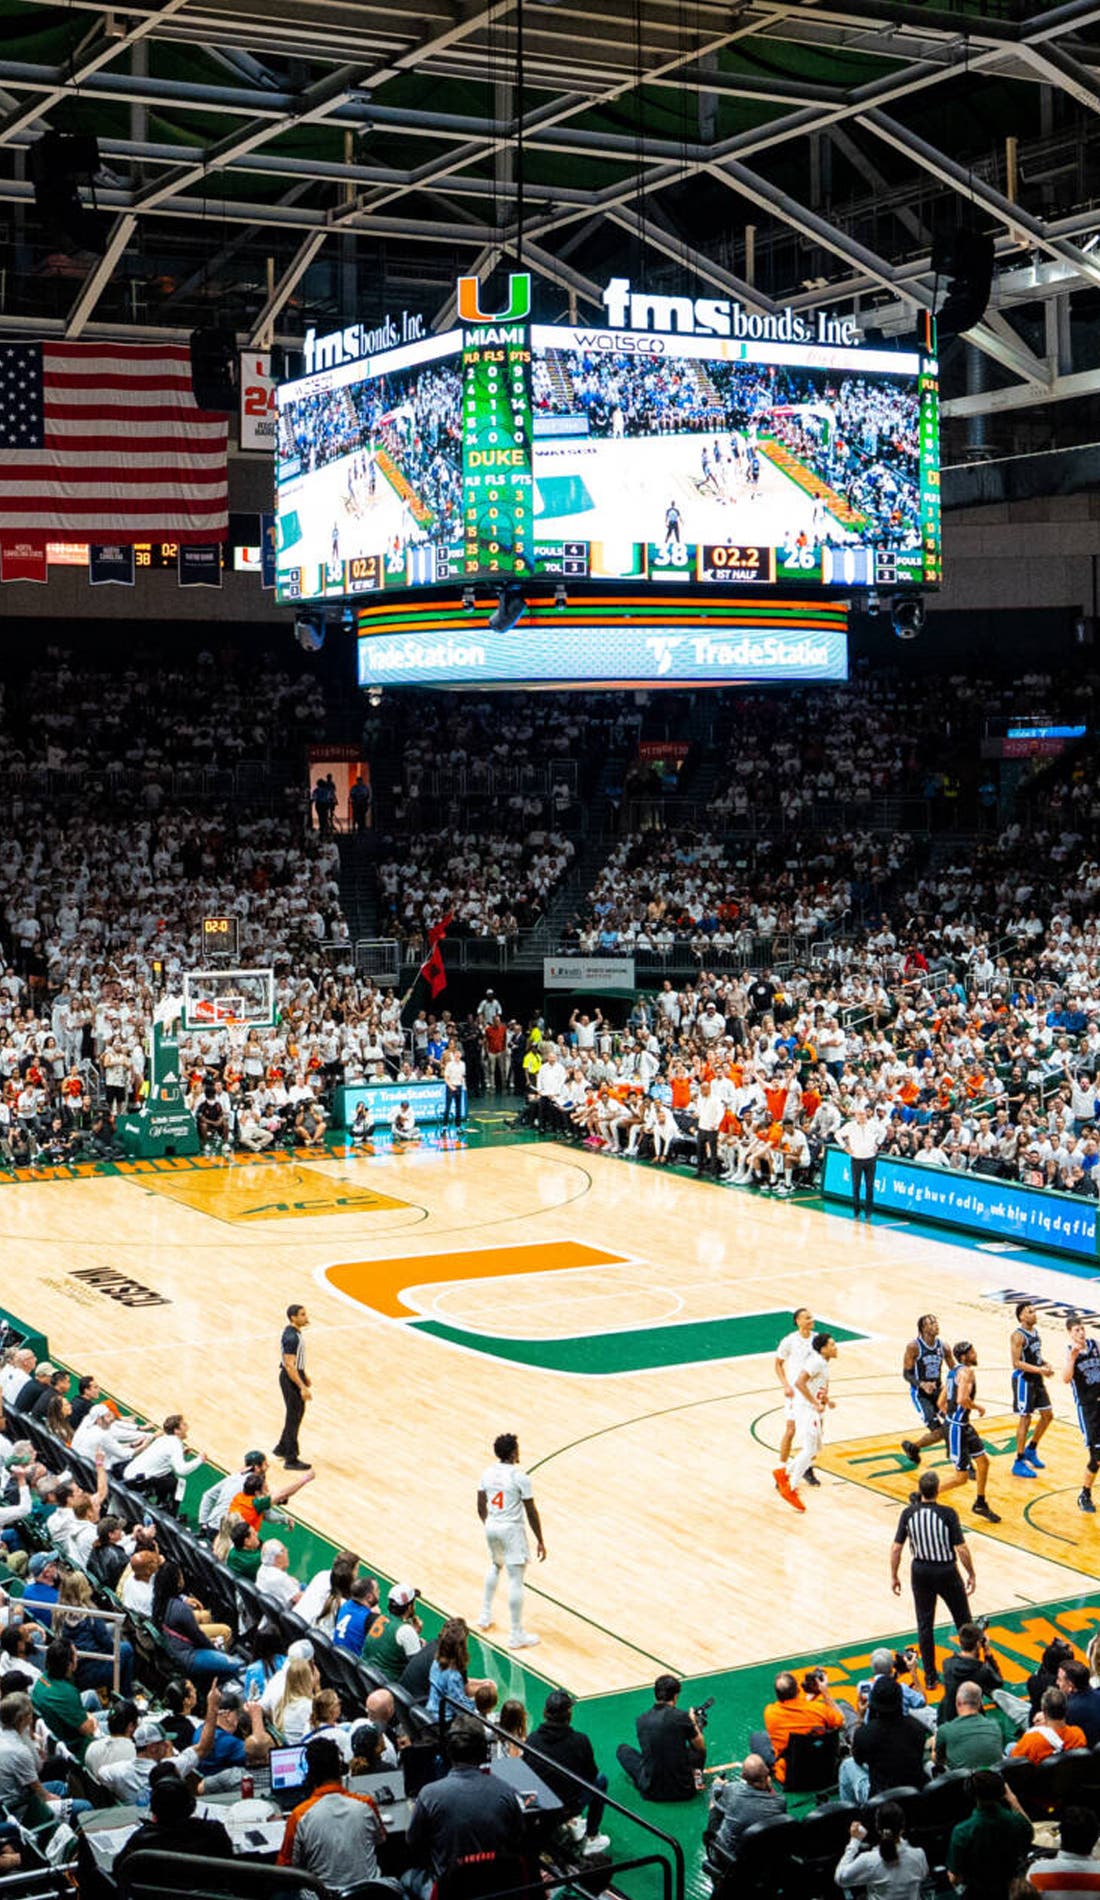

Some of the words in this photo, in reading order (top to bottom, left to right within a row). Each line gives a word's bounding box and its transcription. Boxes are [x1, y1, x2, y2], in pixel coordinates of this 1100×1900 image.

[402, 310, 426, 342] Inc.
[818, 311, 860, 346] Inc.
[465, 328, 525, 346] MIAMI
[573, 333, 665, 353] watsco
[509, 351, 531, 363] PTS
[487, 366, 498, 378] 0
[487, 382, 498, 394] 0
[488, 432, 498, 443] 0
[468, 450, 525, 467] DUKE
[488, 490, 498, 502] 0
[488, 508, 498, 518] 0
[514, 508, 524, 518] 0
[162, 543, 177, 557] 02
[488, 542, 499, 554] 0
[533, 546, 563, 556] FOULS
[654, 543, 689, 566] 38
[136, 552, 151, 566] 38
[489, 560, 499, 571] 2
[712, 547, 760, 567] 02.2
[784, 546, 816, 568] 26
[896, 556, 922, 566] FOULS
[352, 557, 376, 578] 02.2
[544, 562, 562, 572] TOL
[732, 570, 758, 580] HALF
[692, 638, 828, 665] TradeStation
[239, 1195, 380, 1216] ACC
[68, 1266, 173, 1308] WATSCO
[491, 1490, 504, 1510] 4
[336, 1614, 352, 1638] 4
[369, 1615, 390, 1638] 6
